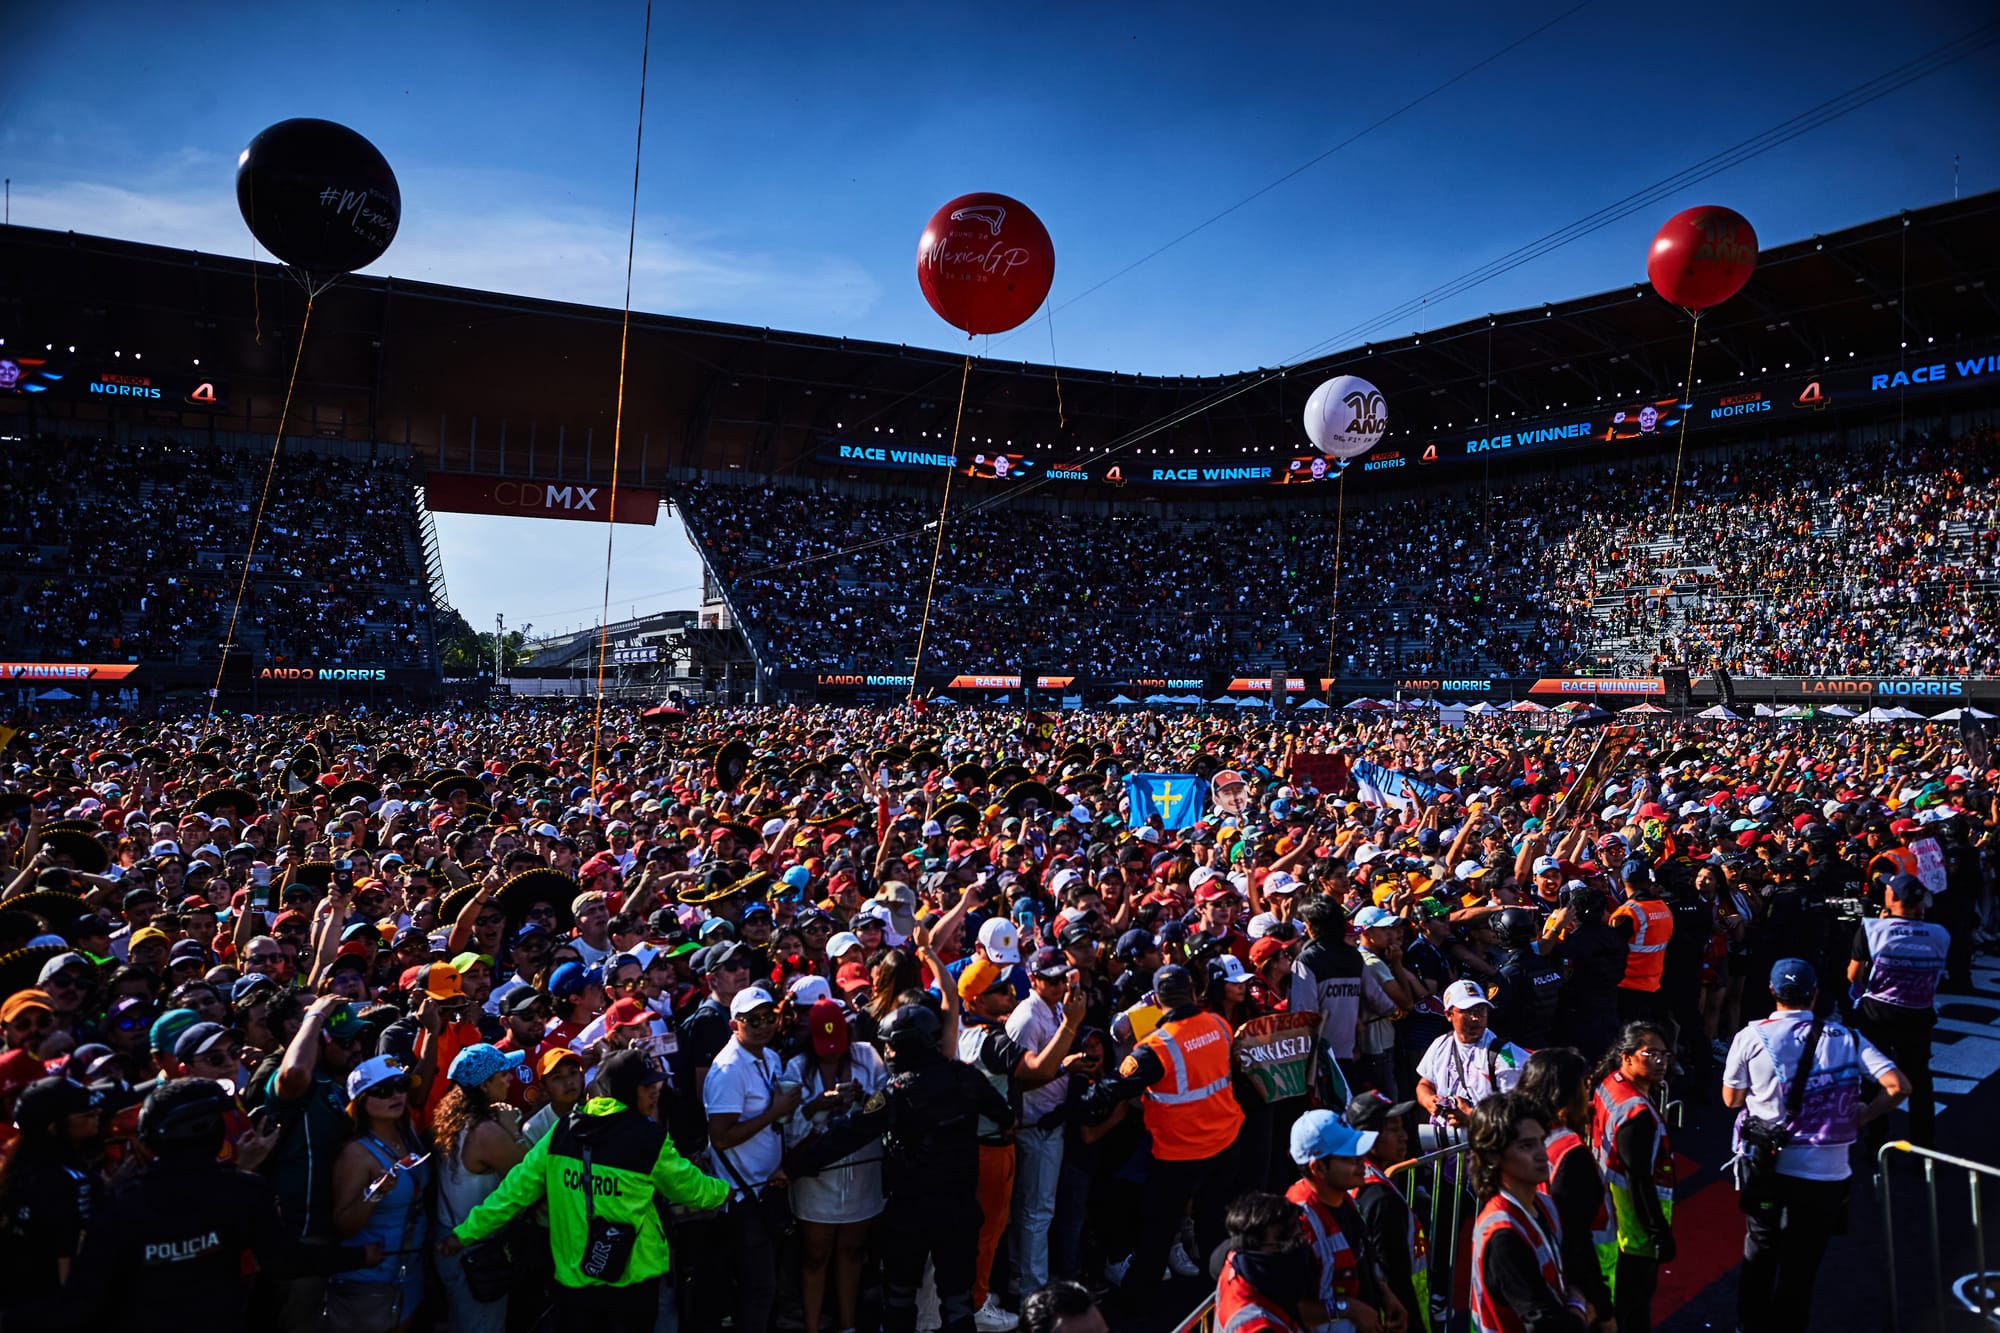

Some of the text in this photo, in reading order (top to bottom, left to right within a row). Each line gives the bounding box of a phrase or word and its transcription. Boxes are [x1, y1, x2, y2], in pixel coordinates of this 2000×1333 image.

[1871, 363, 1946, 390] RACE
[90, 382, 161, 399] NORRIS
[191, 382, 217, 402] 4
[1799, 382, 1825, 404] 4
[1343, 391, 1388, 419] 10
[1710, 399, 1772, 419] NORRIS
[1466, 423, 1592, 454] RACE WINNER
[840, 445, 958, 468] RACE WINNER
[1422, 444, 1438, 460] 4
[1364, 457, 1406, 471] NORRIS
[1046, 469, 1089, 480] NORRIS
[1106, 465, 1123, 481] 4
[1152, 467, 1272, 481] RACE WINNER
[494, 482, 598, 511] CDMX
[8, 666, 91, 678] WINNER
[253, 668, 386, 681] ANDO NORRIS
[817, 675, 914, 686] LANDO NORRIS
[975, 677, 1004, 687] RACE
[1167, 679, 1204, 689] NORRIS
[1247, 680, 1271, 689] RACE
[1442, 680, 1491, 691] NORRIS
[1561, 681, 1659, 692] RACE WINNER
[1801, 681, 1963, 695] LANDO NORRIS
[1532, 971, 1562, 986] POLICIA
[1326, 983, 1360, 998] CONTROL
[144, 1230, 221, 1261] POLICIA
